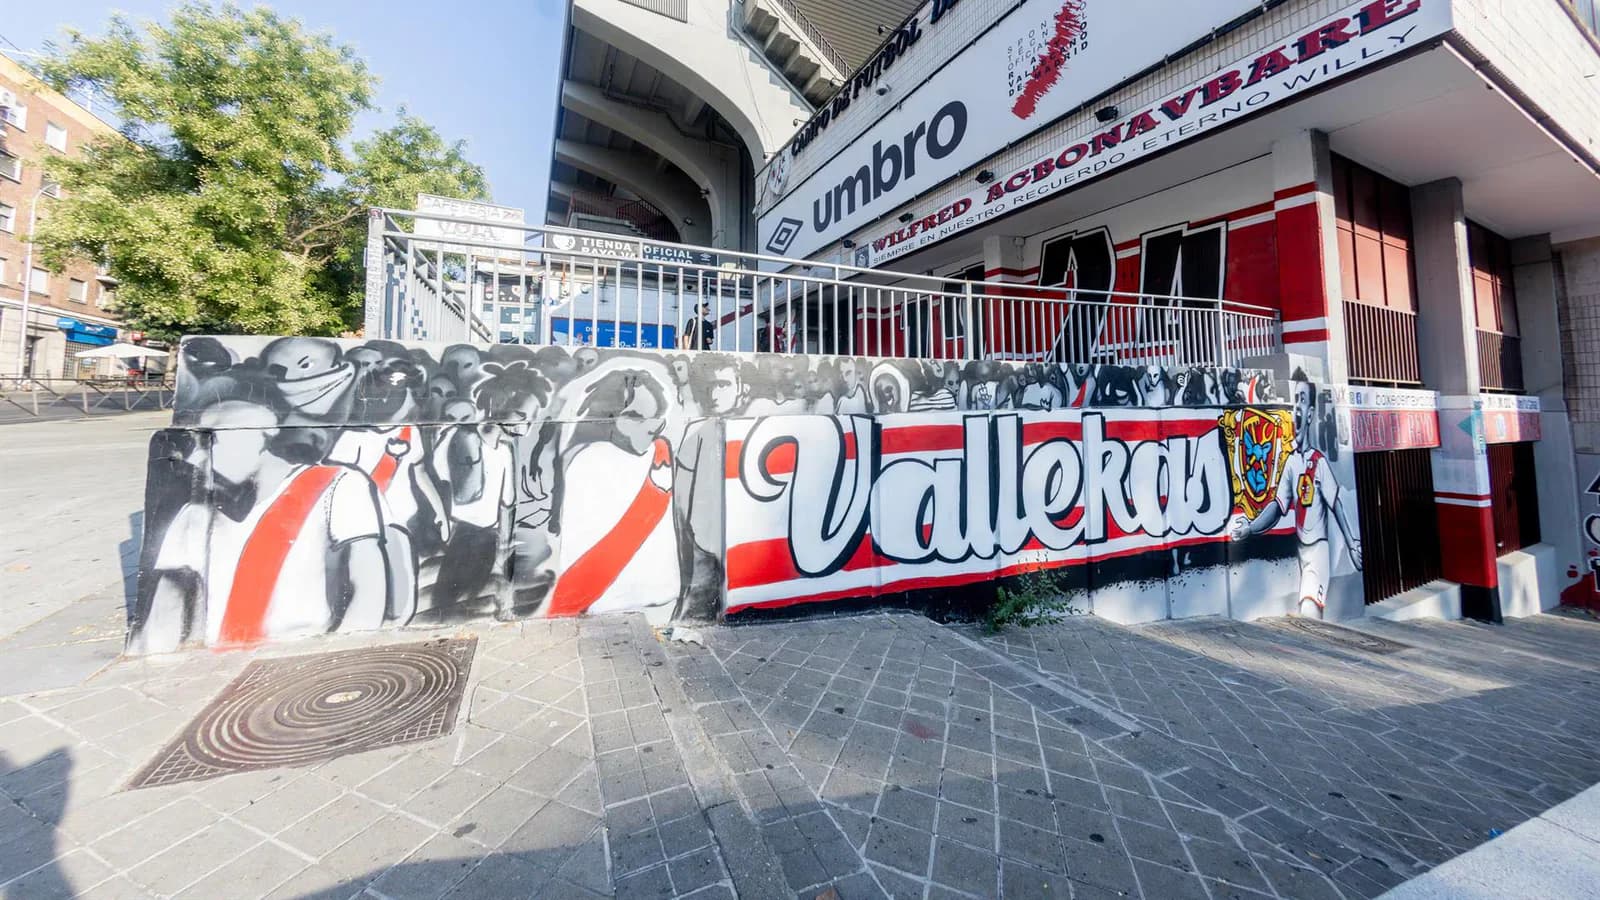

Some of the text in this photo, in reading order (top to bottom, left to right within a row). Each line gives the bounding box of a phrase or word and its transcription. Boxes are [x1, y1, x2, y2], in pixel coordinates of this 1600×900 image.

[852, 18, 922, 99] FUTBOL
[872, 0, 1422, 253] WILFRED AGBONAVBARE
[812, 100, 968, 233] umbro
[873, 24, 1417, 264] SIEMPRE EN NUESTRO RECUERDO ETERNO WILLY
[581, 236, 694, 260] TIENDA OFICIAL
[739, 411, 1232, 577] Vallekas
